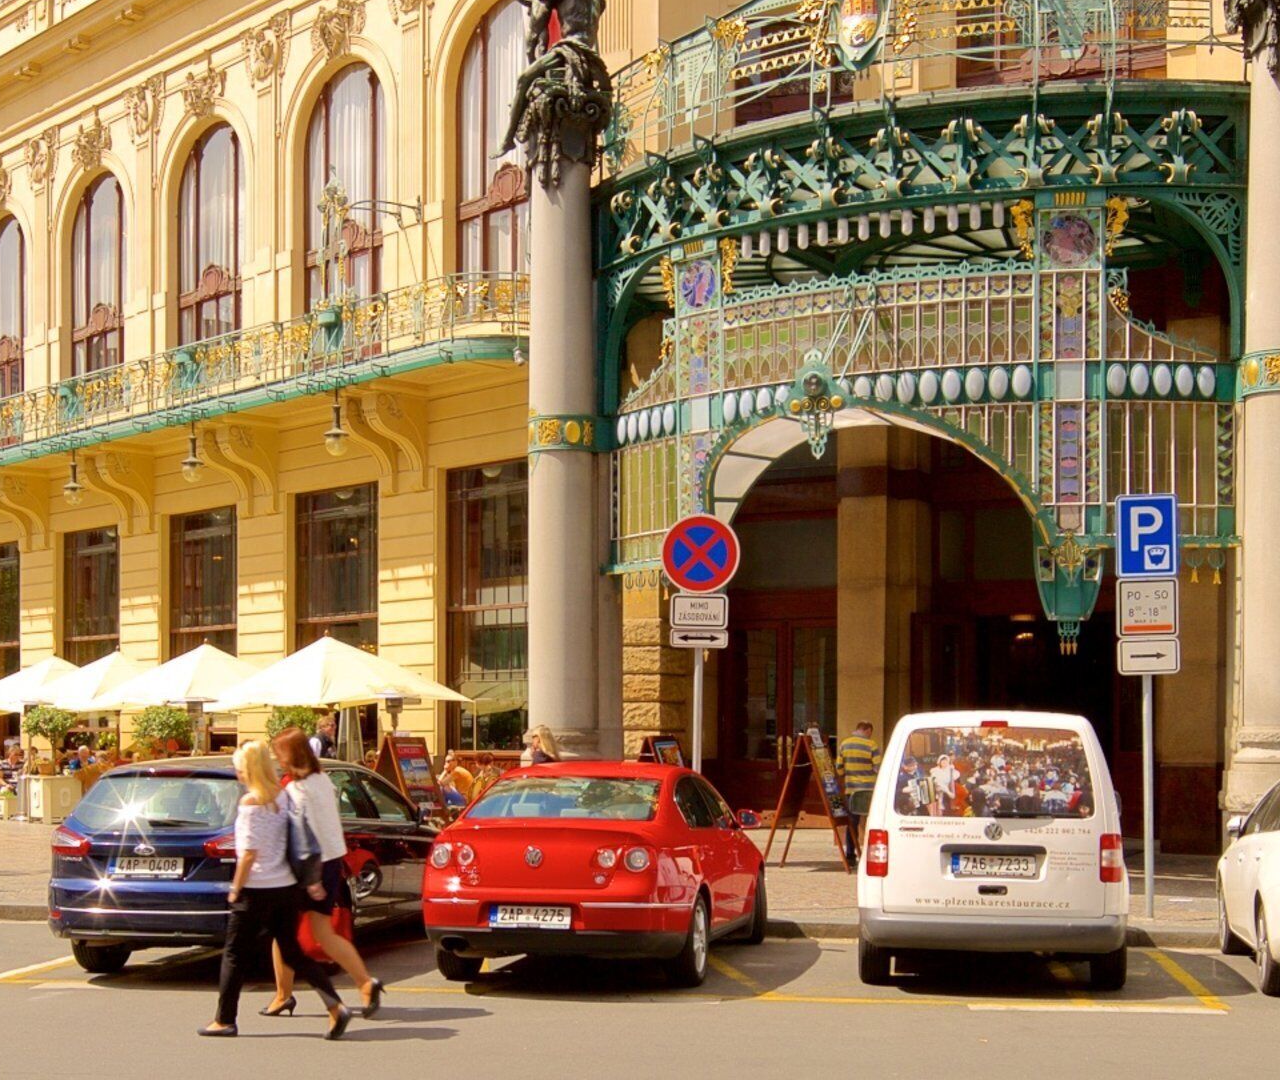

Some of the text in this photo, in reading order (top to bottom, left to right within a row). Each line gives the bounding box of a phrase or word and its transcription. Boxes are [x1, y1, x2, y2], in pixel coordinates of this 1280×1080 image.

[1130, 505, 1163, 552] P
[1126, 591, 1141, 601] PO
[1154, 590, 1169, 600] SO
[690, 601, 709, 610] MIMO
[678, 611, 720, 621] ZÁSOBOVÁNÍ
[119, 857, 178, 872] 4AP 0408
[962, 856, 1029, 872] 7A6 7233
[915, 897, 1070, 909] www.plzenskarestaurace.cz
[500, 908, 565, 923] 2AP 4275
